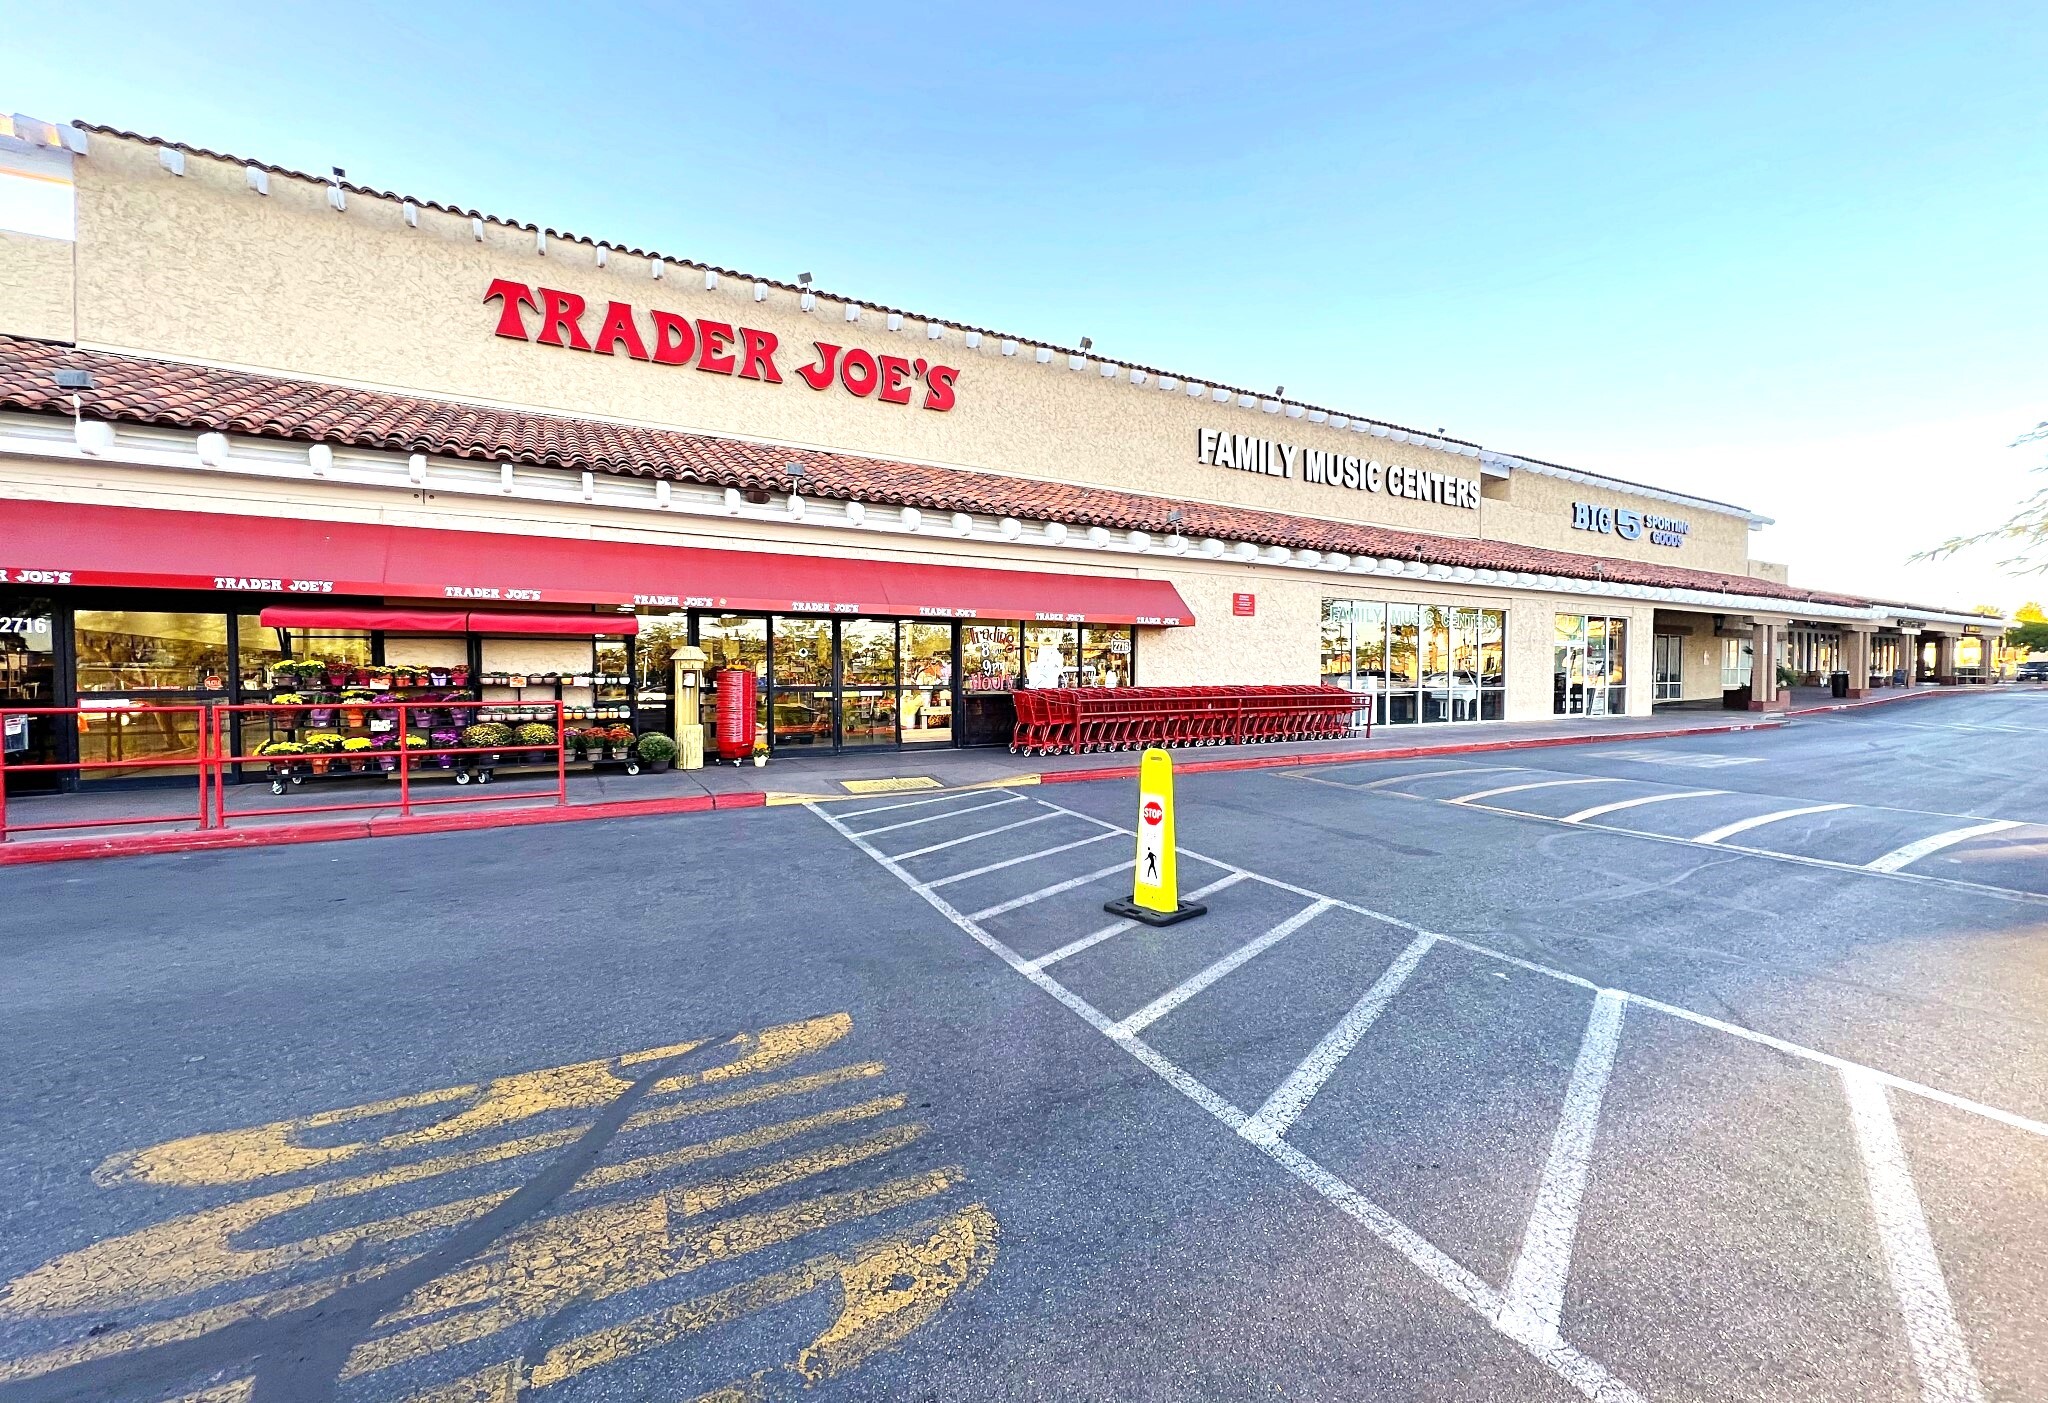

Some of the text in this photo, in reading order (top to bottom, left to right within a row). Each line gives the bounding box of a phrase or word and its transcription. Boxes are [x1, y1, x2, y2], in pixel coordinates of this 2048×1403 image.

[483, 278, 961, 412] TRADER JOE'S
[1198, 428, 1481, 510] FAMILY MUSIC CENTERS
[1572, 502, 1689, 540] BIG 5 SPORTING
[1650, 531, 1683, 547] GOODS
[15, 570, 73, 584] JOE'S
[214, 577, 334, 593] TRADER JOE'S
[444, 586, 542, 600] TRADER JOE'S
[633, 594, 713, 607] TRADER JOE'S
[791, 602, 831, 612] TRADER
[0, 617, 47, 634] 2716
[1330, 606, 1497, 629] FAMILY MUSC CENTERS
[1143, 808, 1162, 819] STOP
